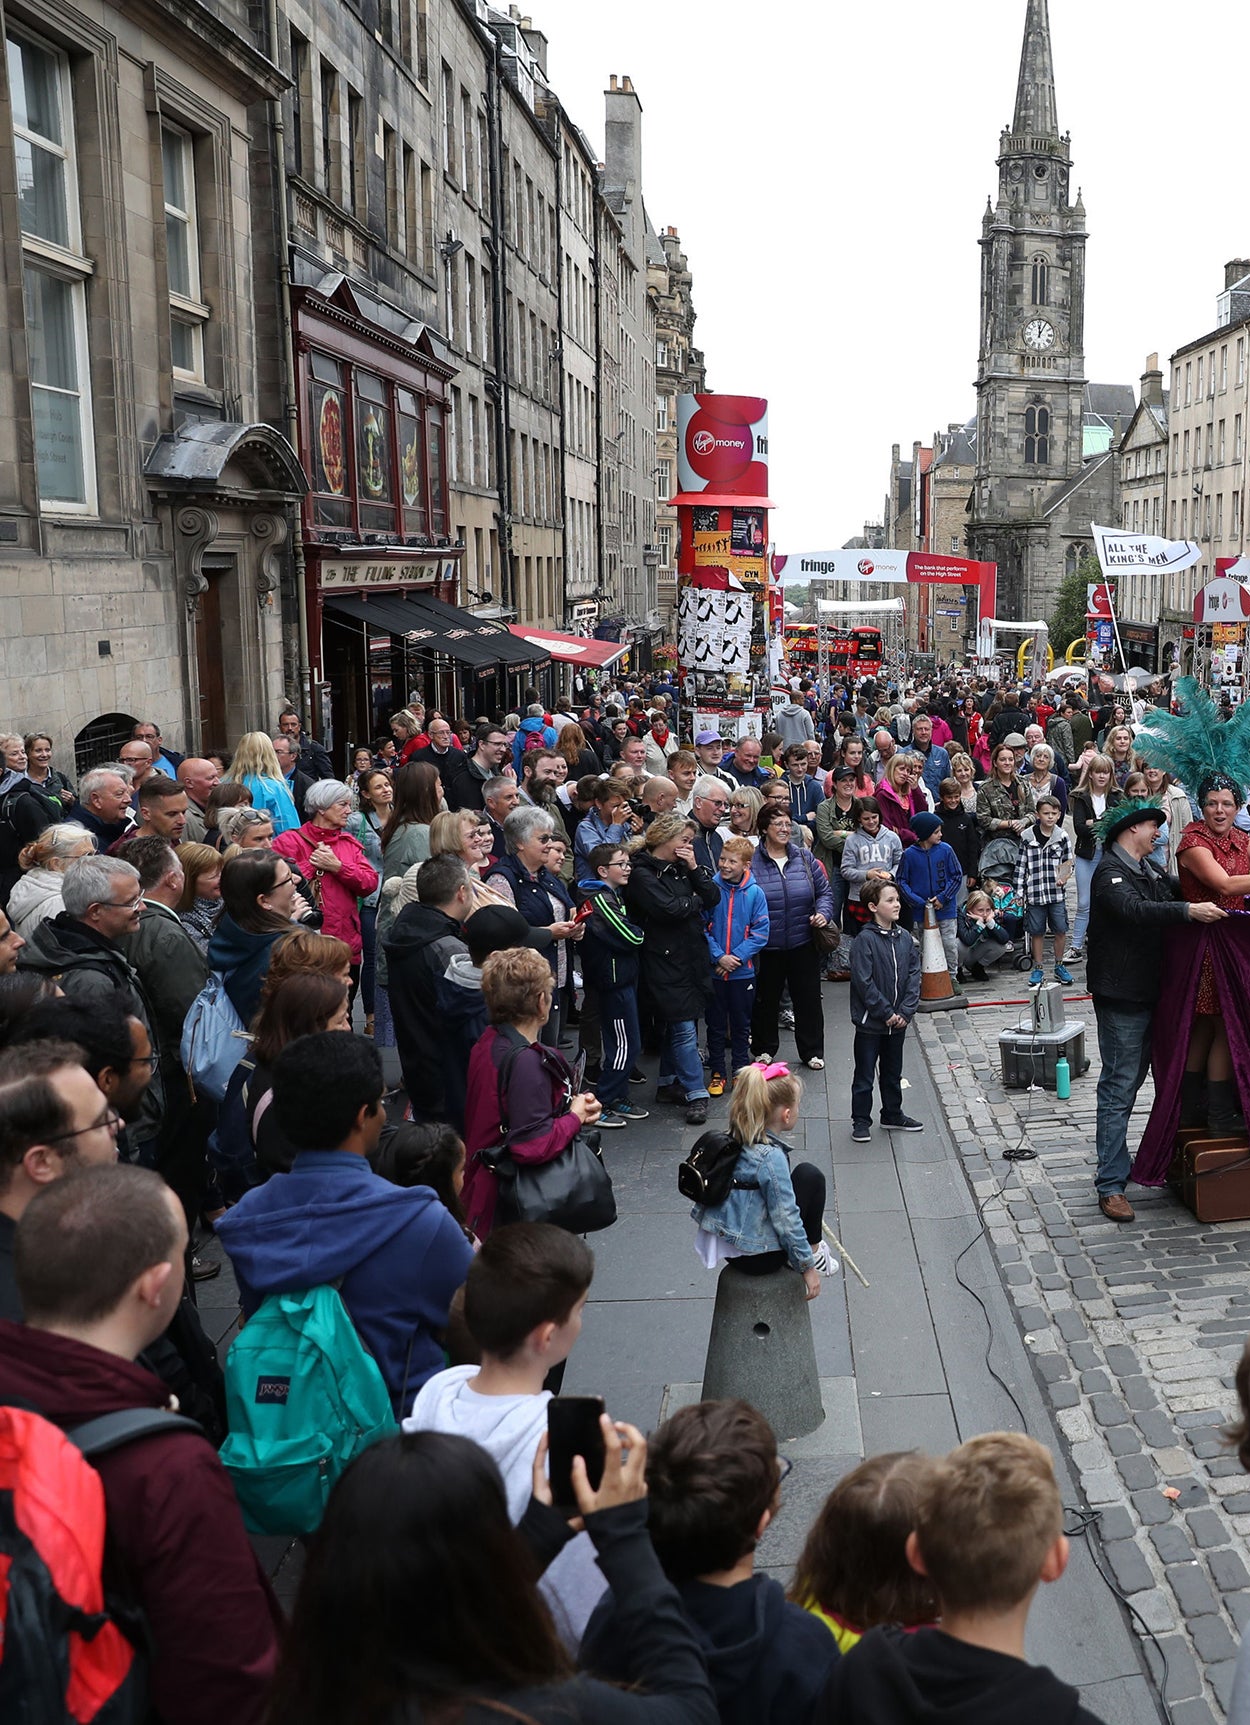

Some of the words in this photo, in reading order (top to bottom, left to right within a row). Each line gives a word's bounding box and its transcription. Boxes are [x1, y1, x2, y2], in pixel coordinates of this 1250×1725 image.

[715, 440, 745, 450] money
[1108, 543, 1126, 553] ALL
[1128, 543, 1147, 554] THE
[1109, 554, 1145, 564] KING'S
[1148, 552, 1169, 564] MEN
[800, 559, 835, 575] fringe
[875, 564, 898, 572] money
[343, 566, 359, 583] THE
[744, 570, 759, 578] GYM
[860, 843, 893, 865] GAP
